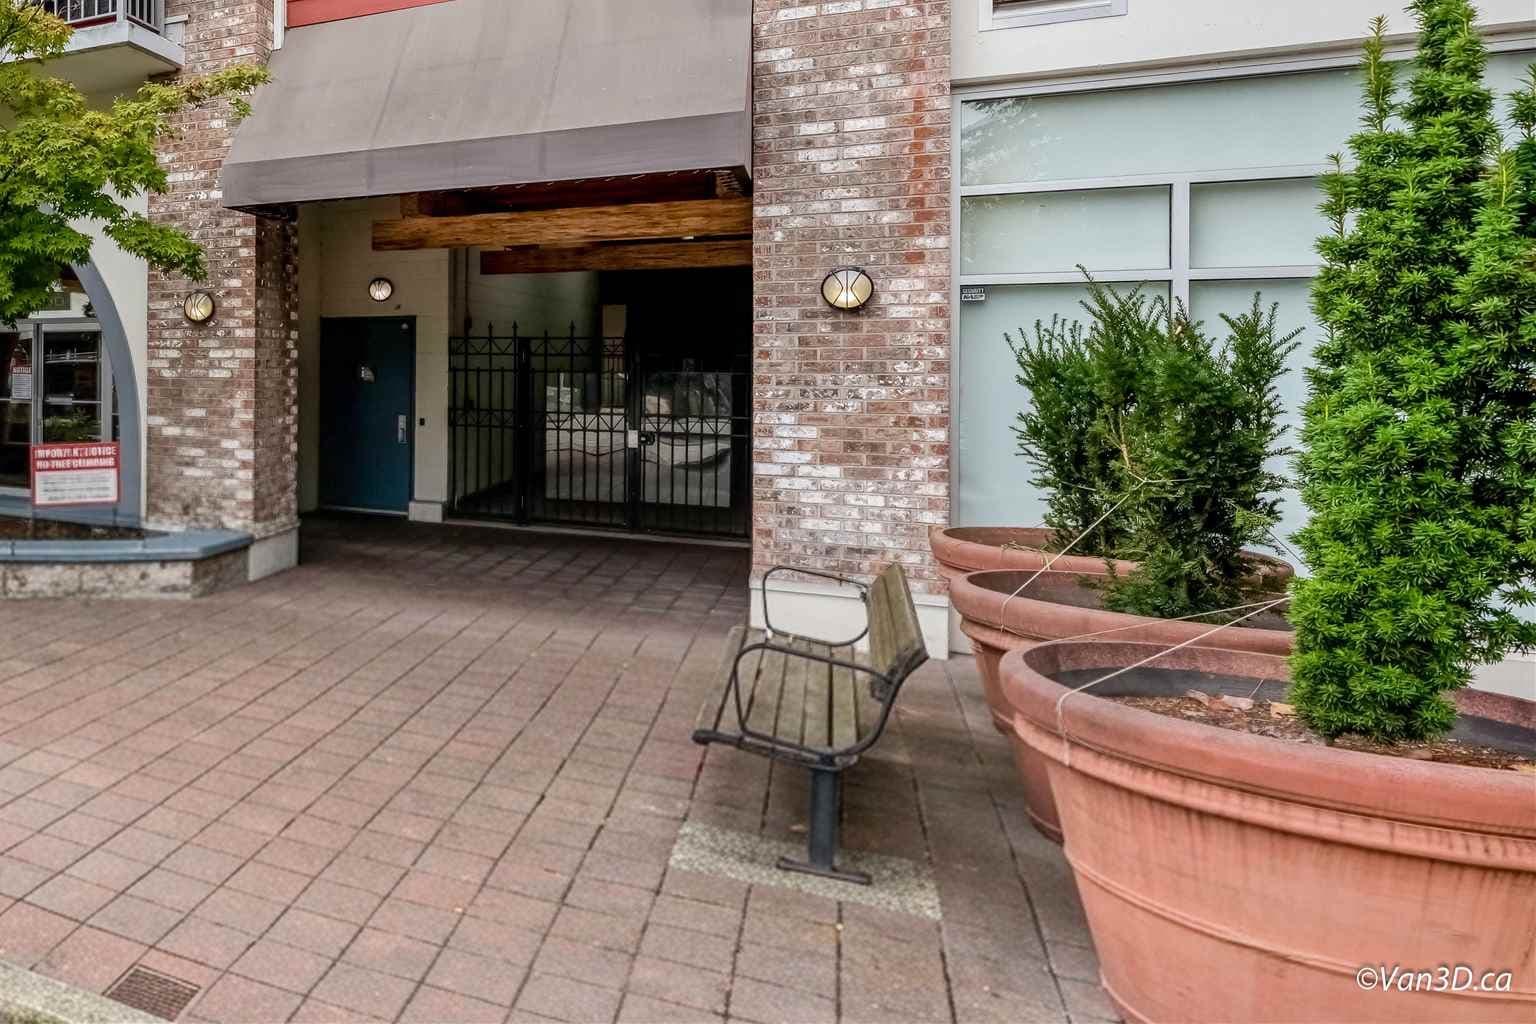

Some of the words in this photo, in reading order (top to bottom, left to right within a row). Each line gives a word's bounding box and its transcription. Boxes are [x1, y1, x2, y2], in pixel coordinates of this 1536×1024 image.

[34, 448, 83, 459] IMPORTANT
[85, 446, 117, 457] NOTICE
[36, 460, 49, 470] NO
[50, 459, 72, 469] TREE
[72, 458, 115, 468] CLIMBING
